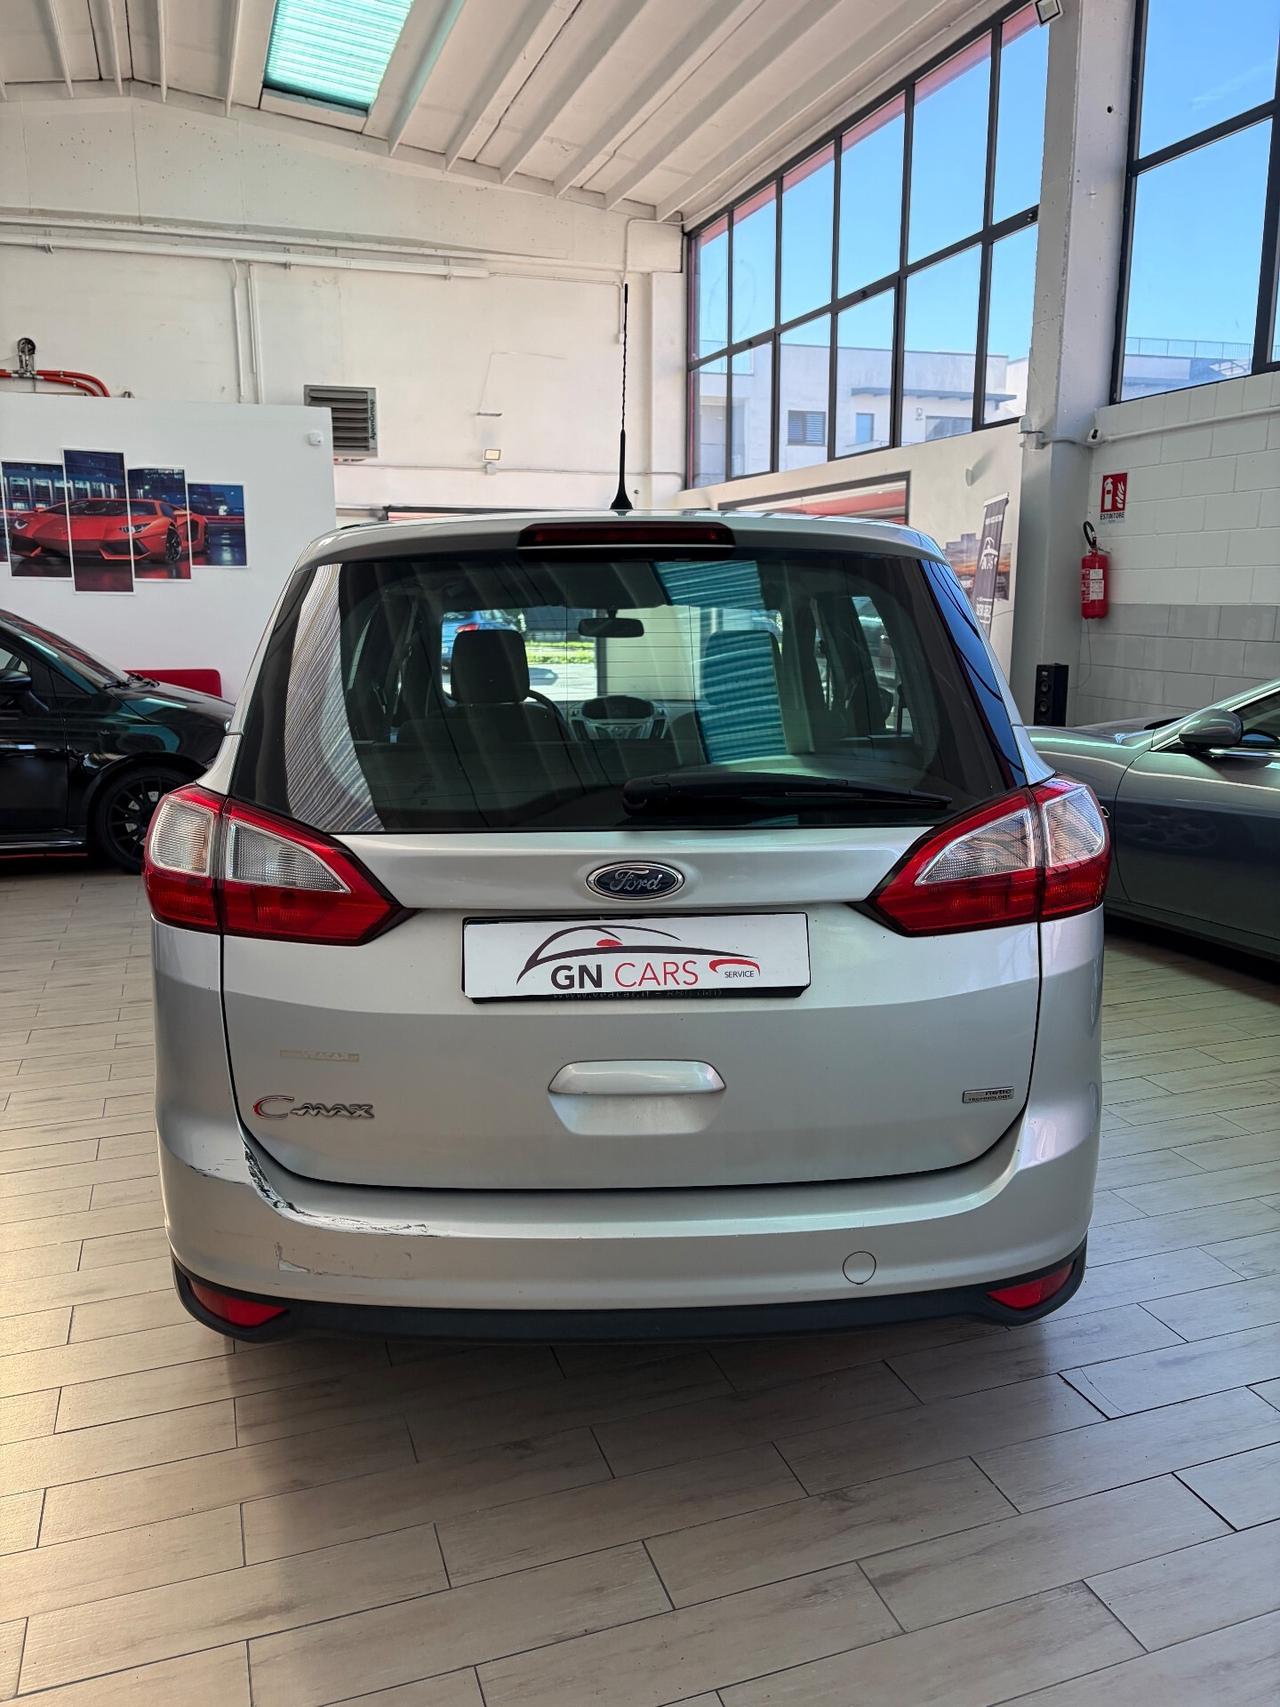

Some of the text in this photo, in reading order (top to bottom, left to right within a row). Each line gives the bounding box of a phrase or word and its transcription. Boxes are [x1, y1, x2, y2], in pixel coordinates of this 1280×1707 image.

[609, 869, 663, 891] Ford
[551, 960, 699, 989] GN CARS
[724, 970, 755, 979] SERVICE
